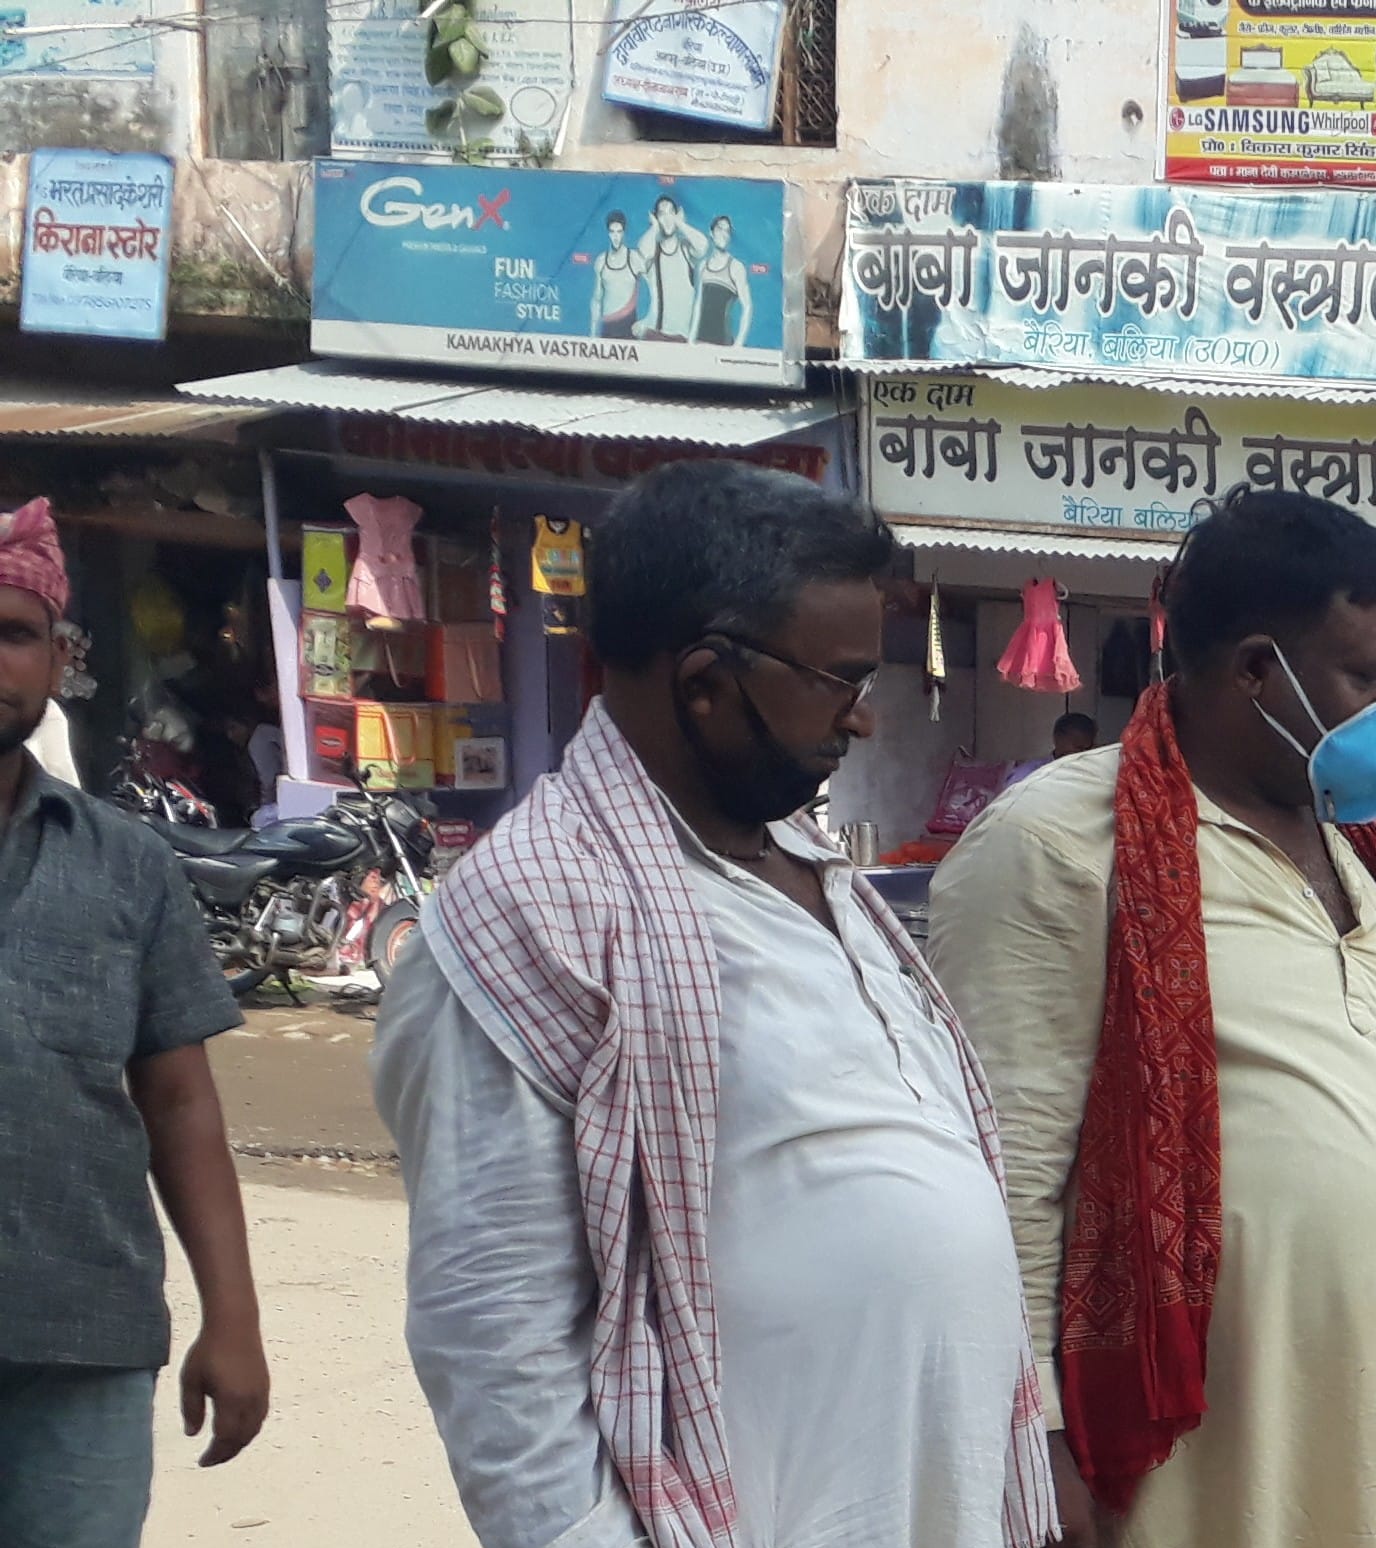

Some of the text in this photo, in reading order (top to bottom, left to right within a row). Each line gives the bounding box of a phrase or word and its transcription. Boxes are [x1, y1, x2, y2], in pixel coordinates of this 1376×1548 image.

[1188, 112, 1203, 127] LG
[1204, 108, 1310, 134] SAMSUNG
[1312, 112, 1369, 136] Whirlpool
[848, 185, 956, 223] एक दाम
[33, 206, 161, 261] किराना स्टोर
[494, 256, 535, 279] FUN
[851, 227, 978, 309] बाबा
[995, 208, 1204, 317] जानकी
[494, 281, 560, 301] FASHION
[516, 302, 561, 321] STYLE
[446, 332, 640, 363] KAMAKHYA VASTRALAYA
[1102, 324, 1180, 361] बलिया
[873, 380, 976, 411] एक दाम
[876, 413, 1002, 483] बाबा
[1020, 405, 1223, 496] जानकी
[1061, 494, 1123, 527] बैरिया
